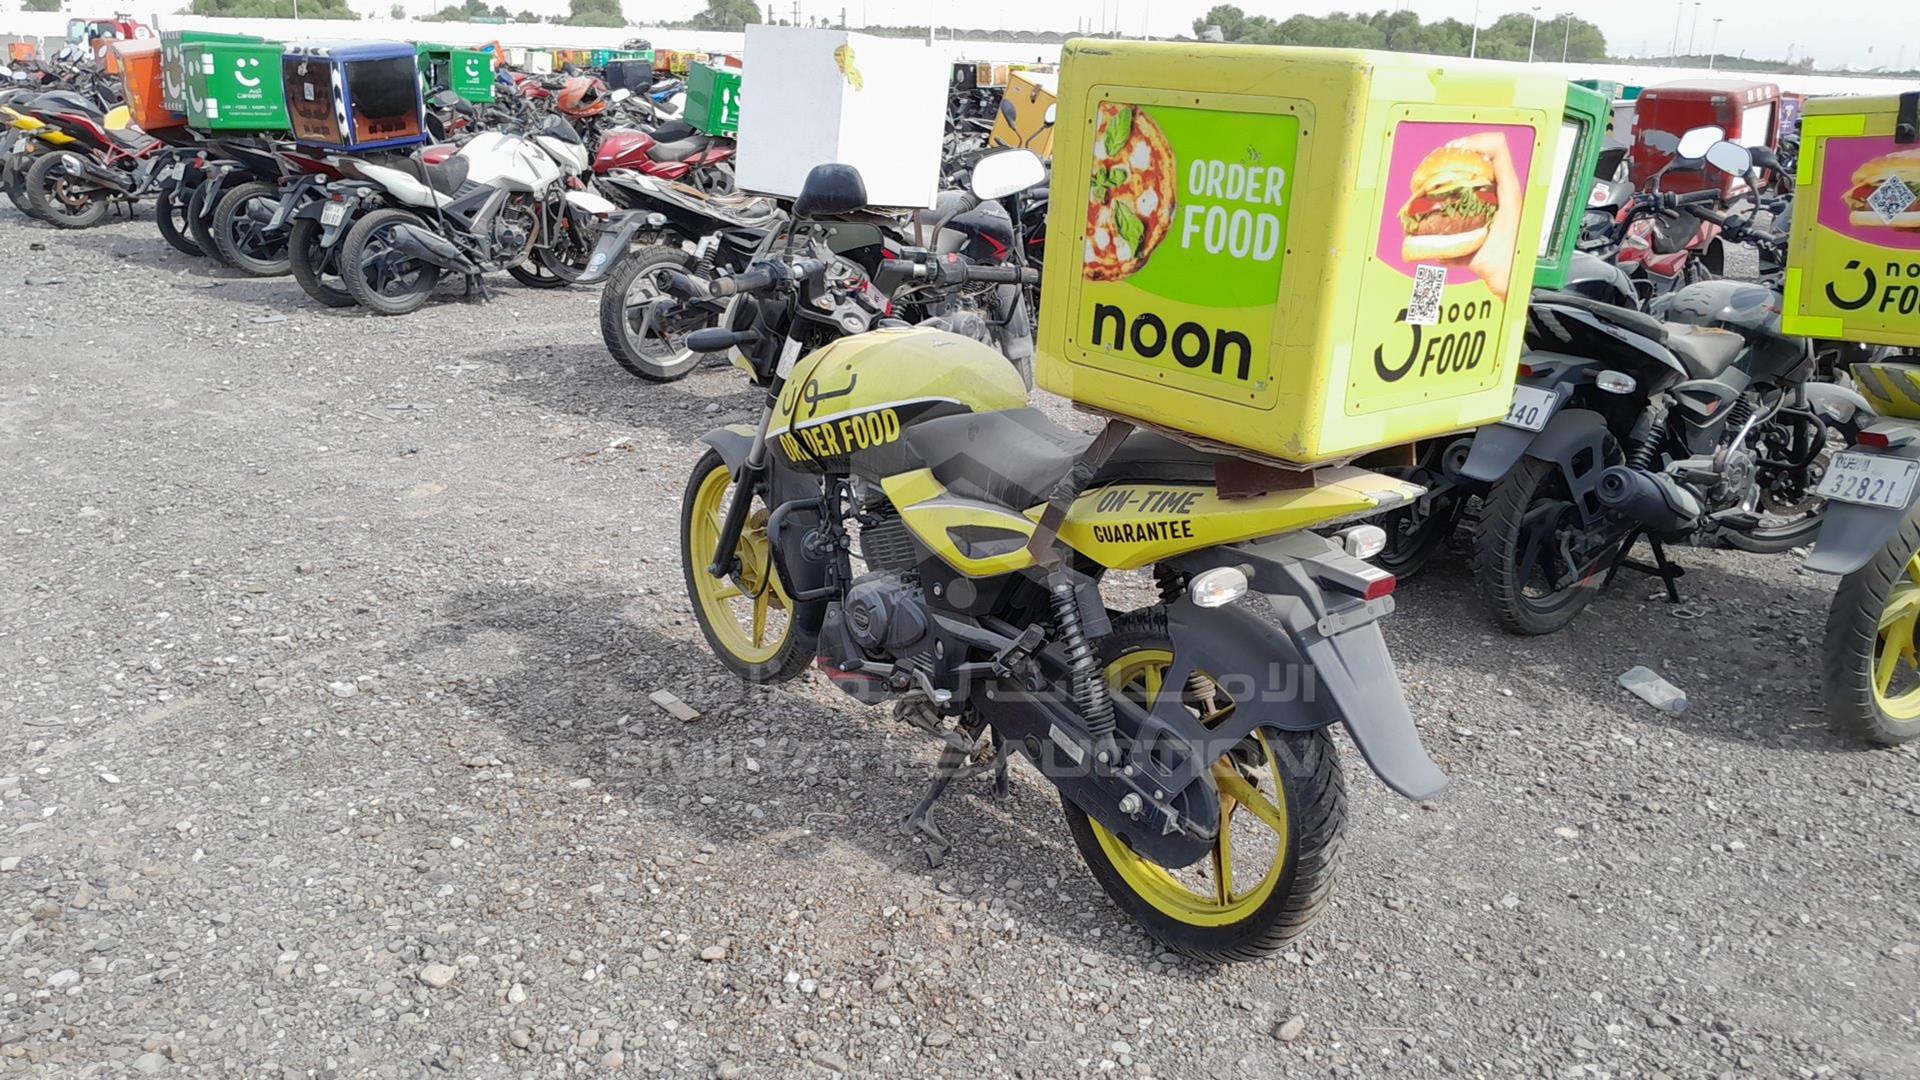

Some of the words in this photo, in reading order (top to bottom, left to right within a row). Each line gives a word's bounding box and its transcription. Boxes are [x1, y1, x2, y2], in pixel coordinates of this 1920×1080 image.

[1188, 158, 1286, 207] ORDER
[1181, 204, 1281, 262] FOOD
[1878, 285, 1920, 315] FO
[1091, 302, 1252, 381] noon
[1419, 329, 1487, 377] FOOD
[779, 423, 842, 462] ORDER
[838, 408, 901, 452] FOOD
[1096, 489, 1204, 514] ON-TIME
[1831, 473, 1896, 503] 32821
[1093, 519, 1195, 544] GUARANTEE
